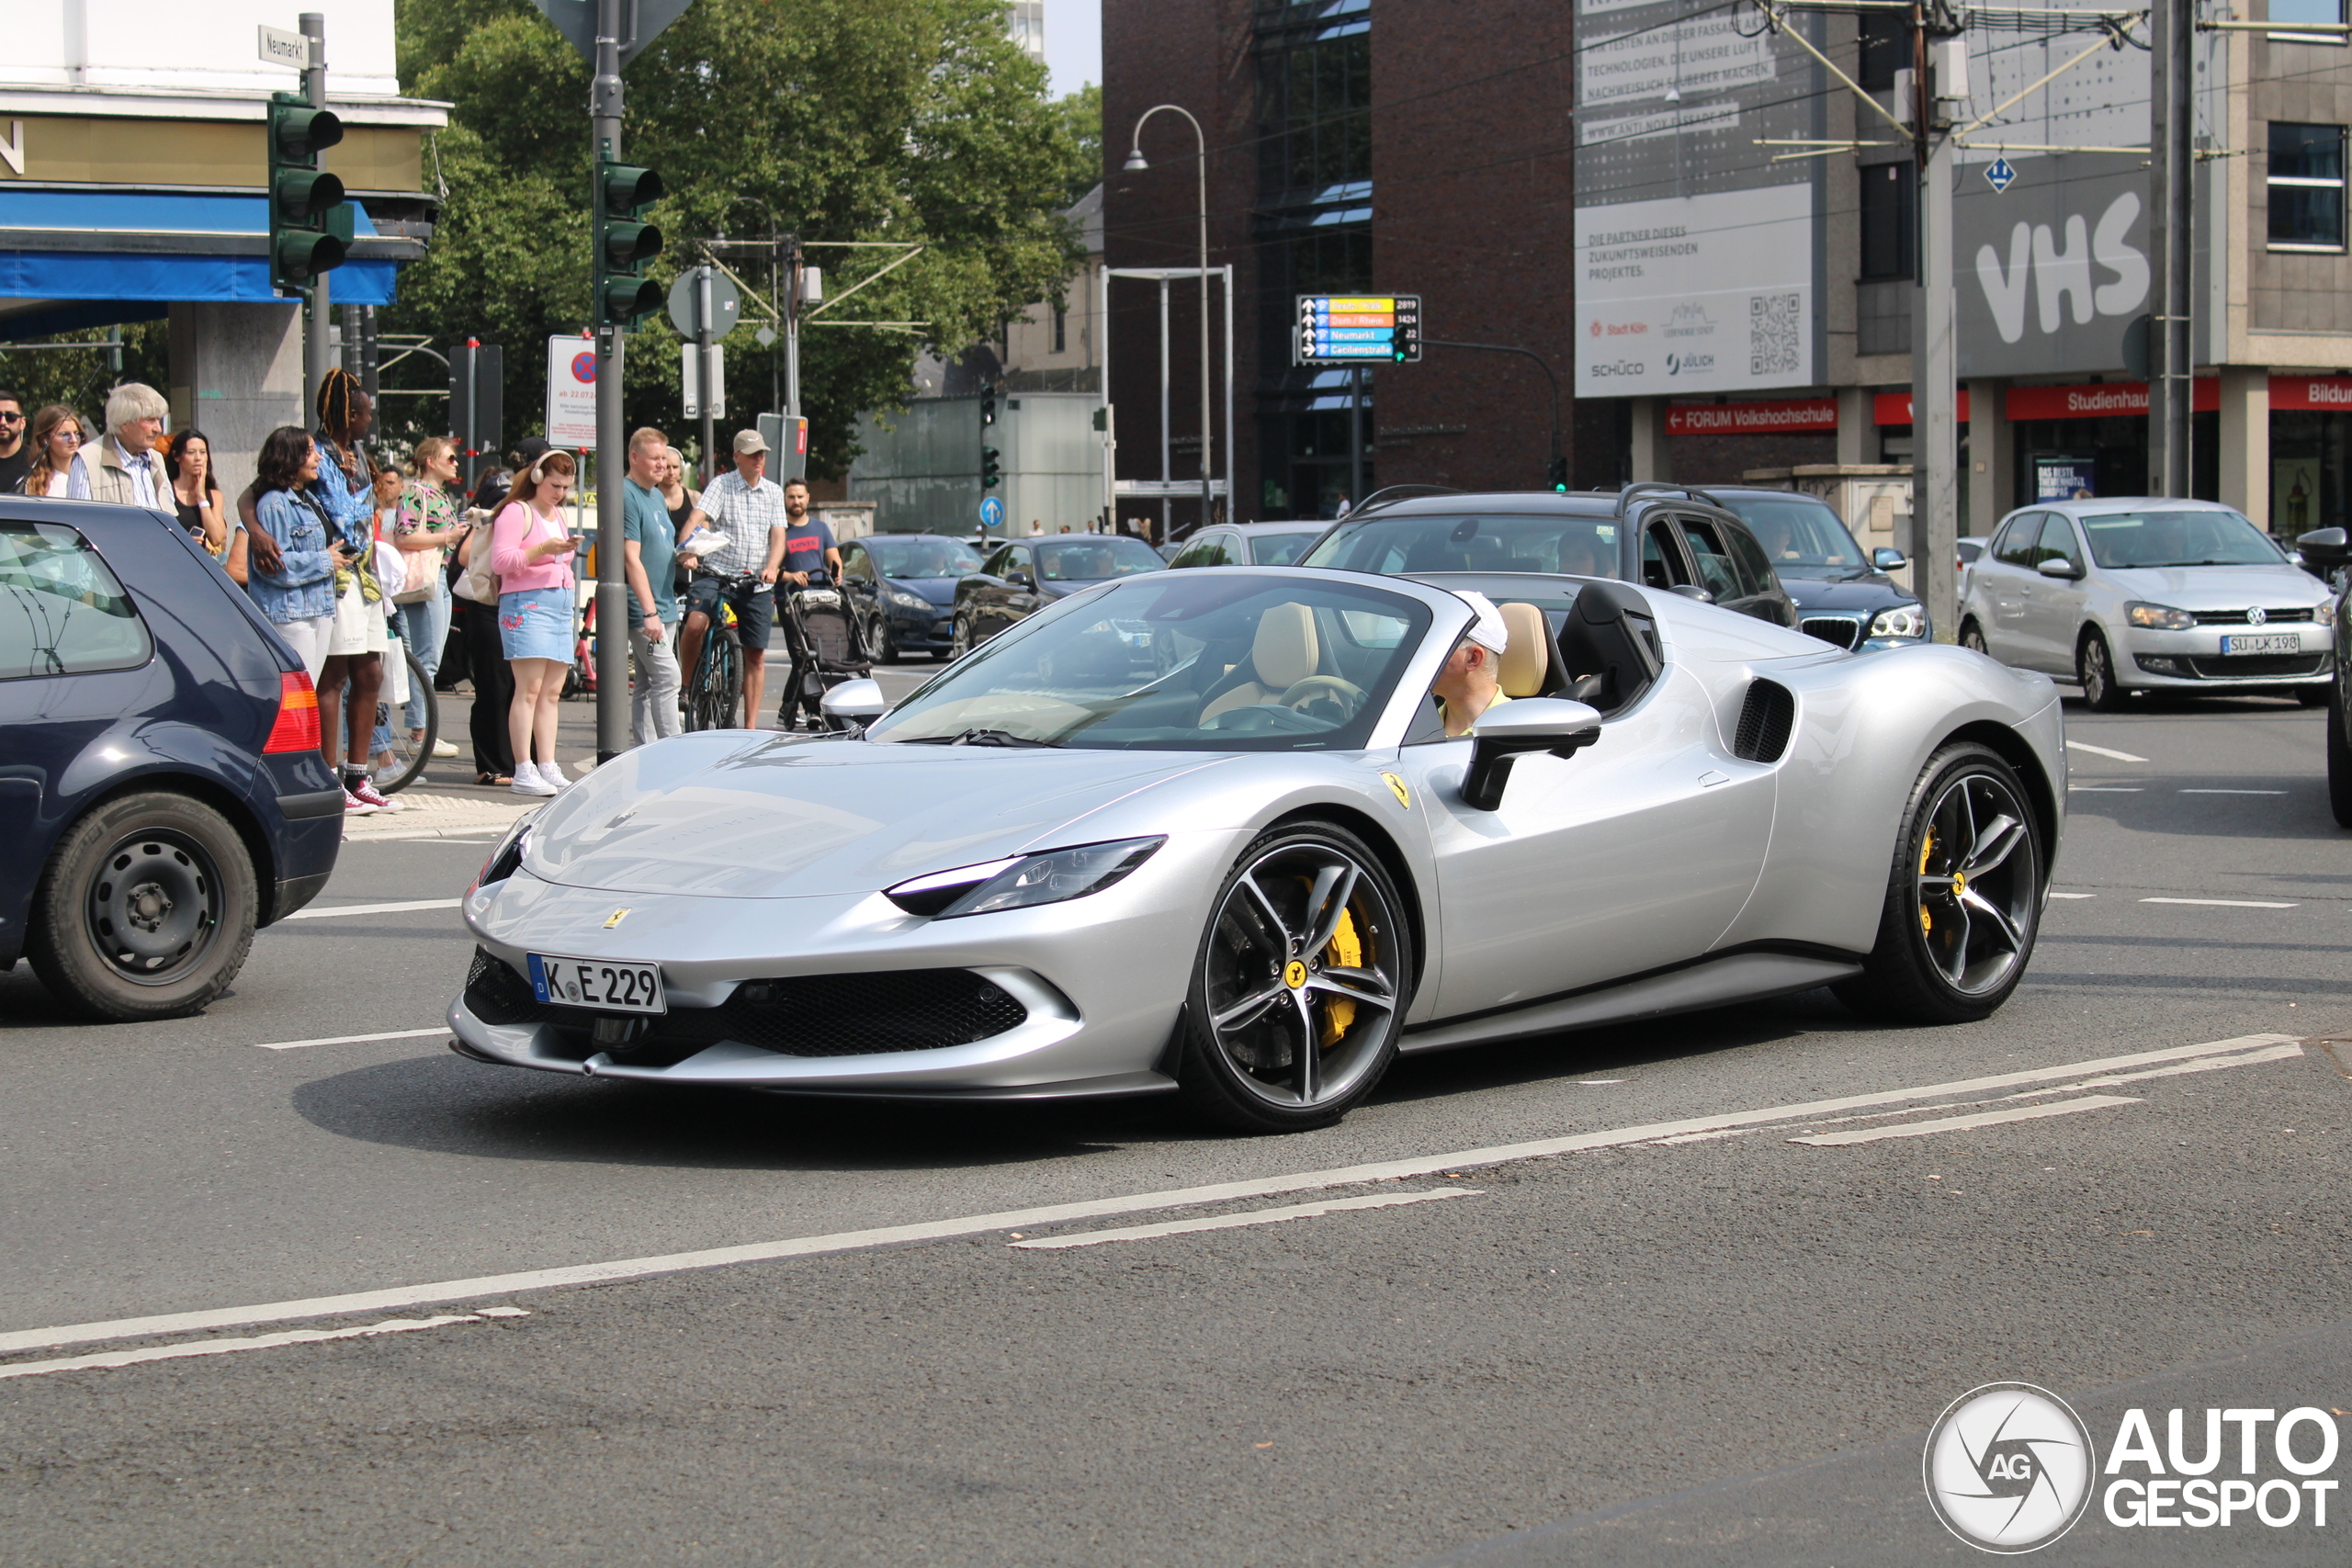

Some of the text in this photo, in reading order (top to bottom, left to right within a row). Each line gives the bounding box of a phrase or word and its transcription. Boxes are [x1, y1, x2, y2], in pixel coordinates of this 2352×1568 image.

[266, 32, 303, 61] Neumarkt
[1609, 37, 1644, 51] TESTEN
[1645, 34, 1659, 45] AN
[1662, 26, 1696, 43] DIESER
[1588, 40, 1759, 77] TECHNOLOGIEN, DIE UNSERE LUFT
[1588, 78, 1664, 100] NACHWEISLICH
[1723, 62, 1772, 81] MACHEN.
[1589, 226, 1687, 246] DIE PARTNER DIESES
[1589, 243, 1699, 263] ZUKUNFTSWEISENDEN
[1975, 191, 2151, 344] VHS
[1331, 315, 1351, 324] Dom
[1360, 315, 1384, 325] Rhein
[1608, 321, 1648, 335] Stadt Köln
[1332, 330, 1375, 340] Neumarkt
[1331, 344, 1391, 355] Cäcilienstraße
[1591, 359, 1645, 377] SCHÜCO
[1682, 353, 1714, 367] JÜLICH
[571, 390, 596, 399] 22.07.2
[2068, 389, 2150, 411] Studienhau
[1685, 406, 1834, 428] FORUM Volkshochschule
[2038, 466, 2075, 478] DAS BESTE
[2231, 636, 2297, 651] SU LK 198
[537, 982, 545, 994] D
[544, 961, 657, 1007] K E 229
